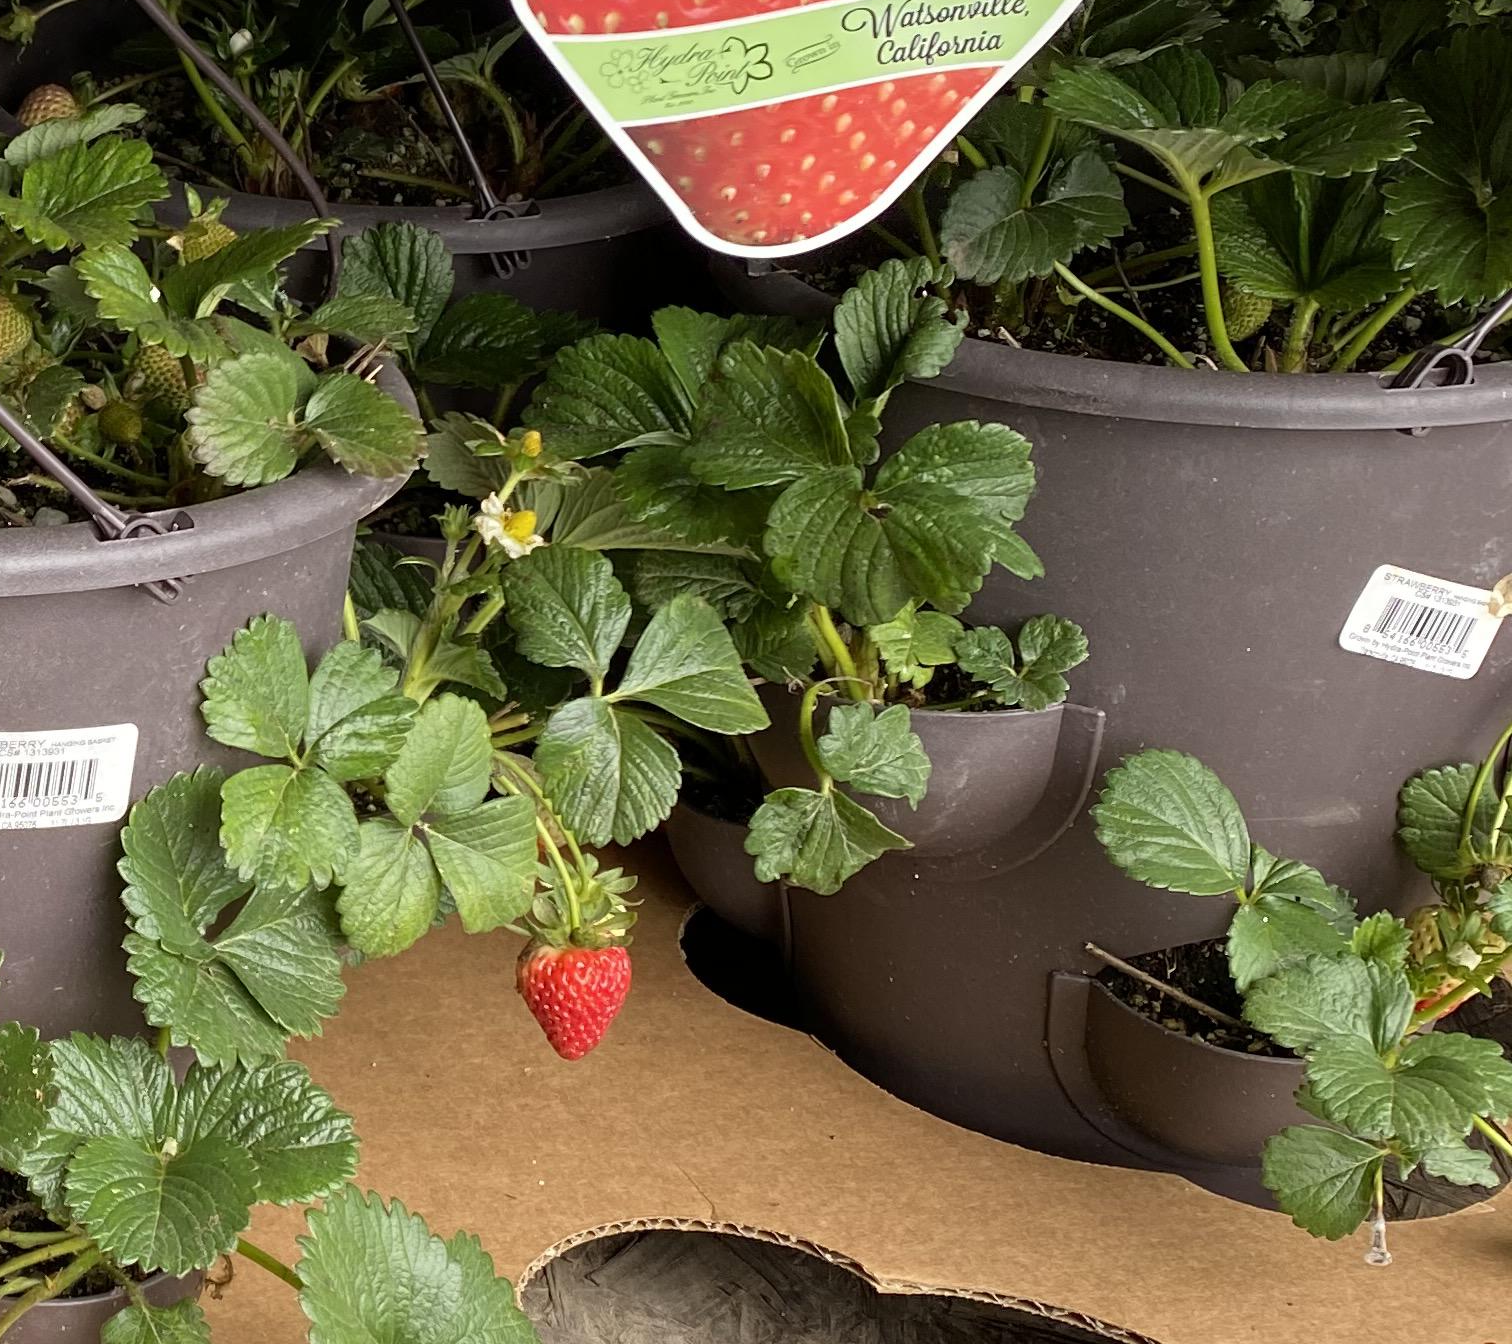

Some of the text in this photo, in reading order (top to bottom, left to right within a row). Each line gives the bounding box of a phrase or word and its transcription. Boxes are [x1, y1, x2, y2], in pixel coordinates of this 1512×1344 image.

[628, 42, 716, 76] Hydra
[876, 29, 1006, 66] California
[684, 60, 752, 87] Point
[1383, 572, 1453, 597] STRAWBERRY
[25, 747, 65, 757] 1313931
[32, 795, 79, 808] 00553
[95, 791, 105, 803] 5
[39, 807, 62, 818] Plant
[63, 805, 100, 816] Growers
